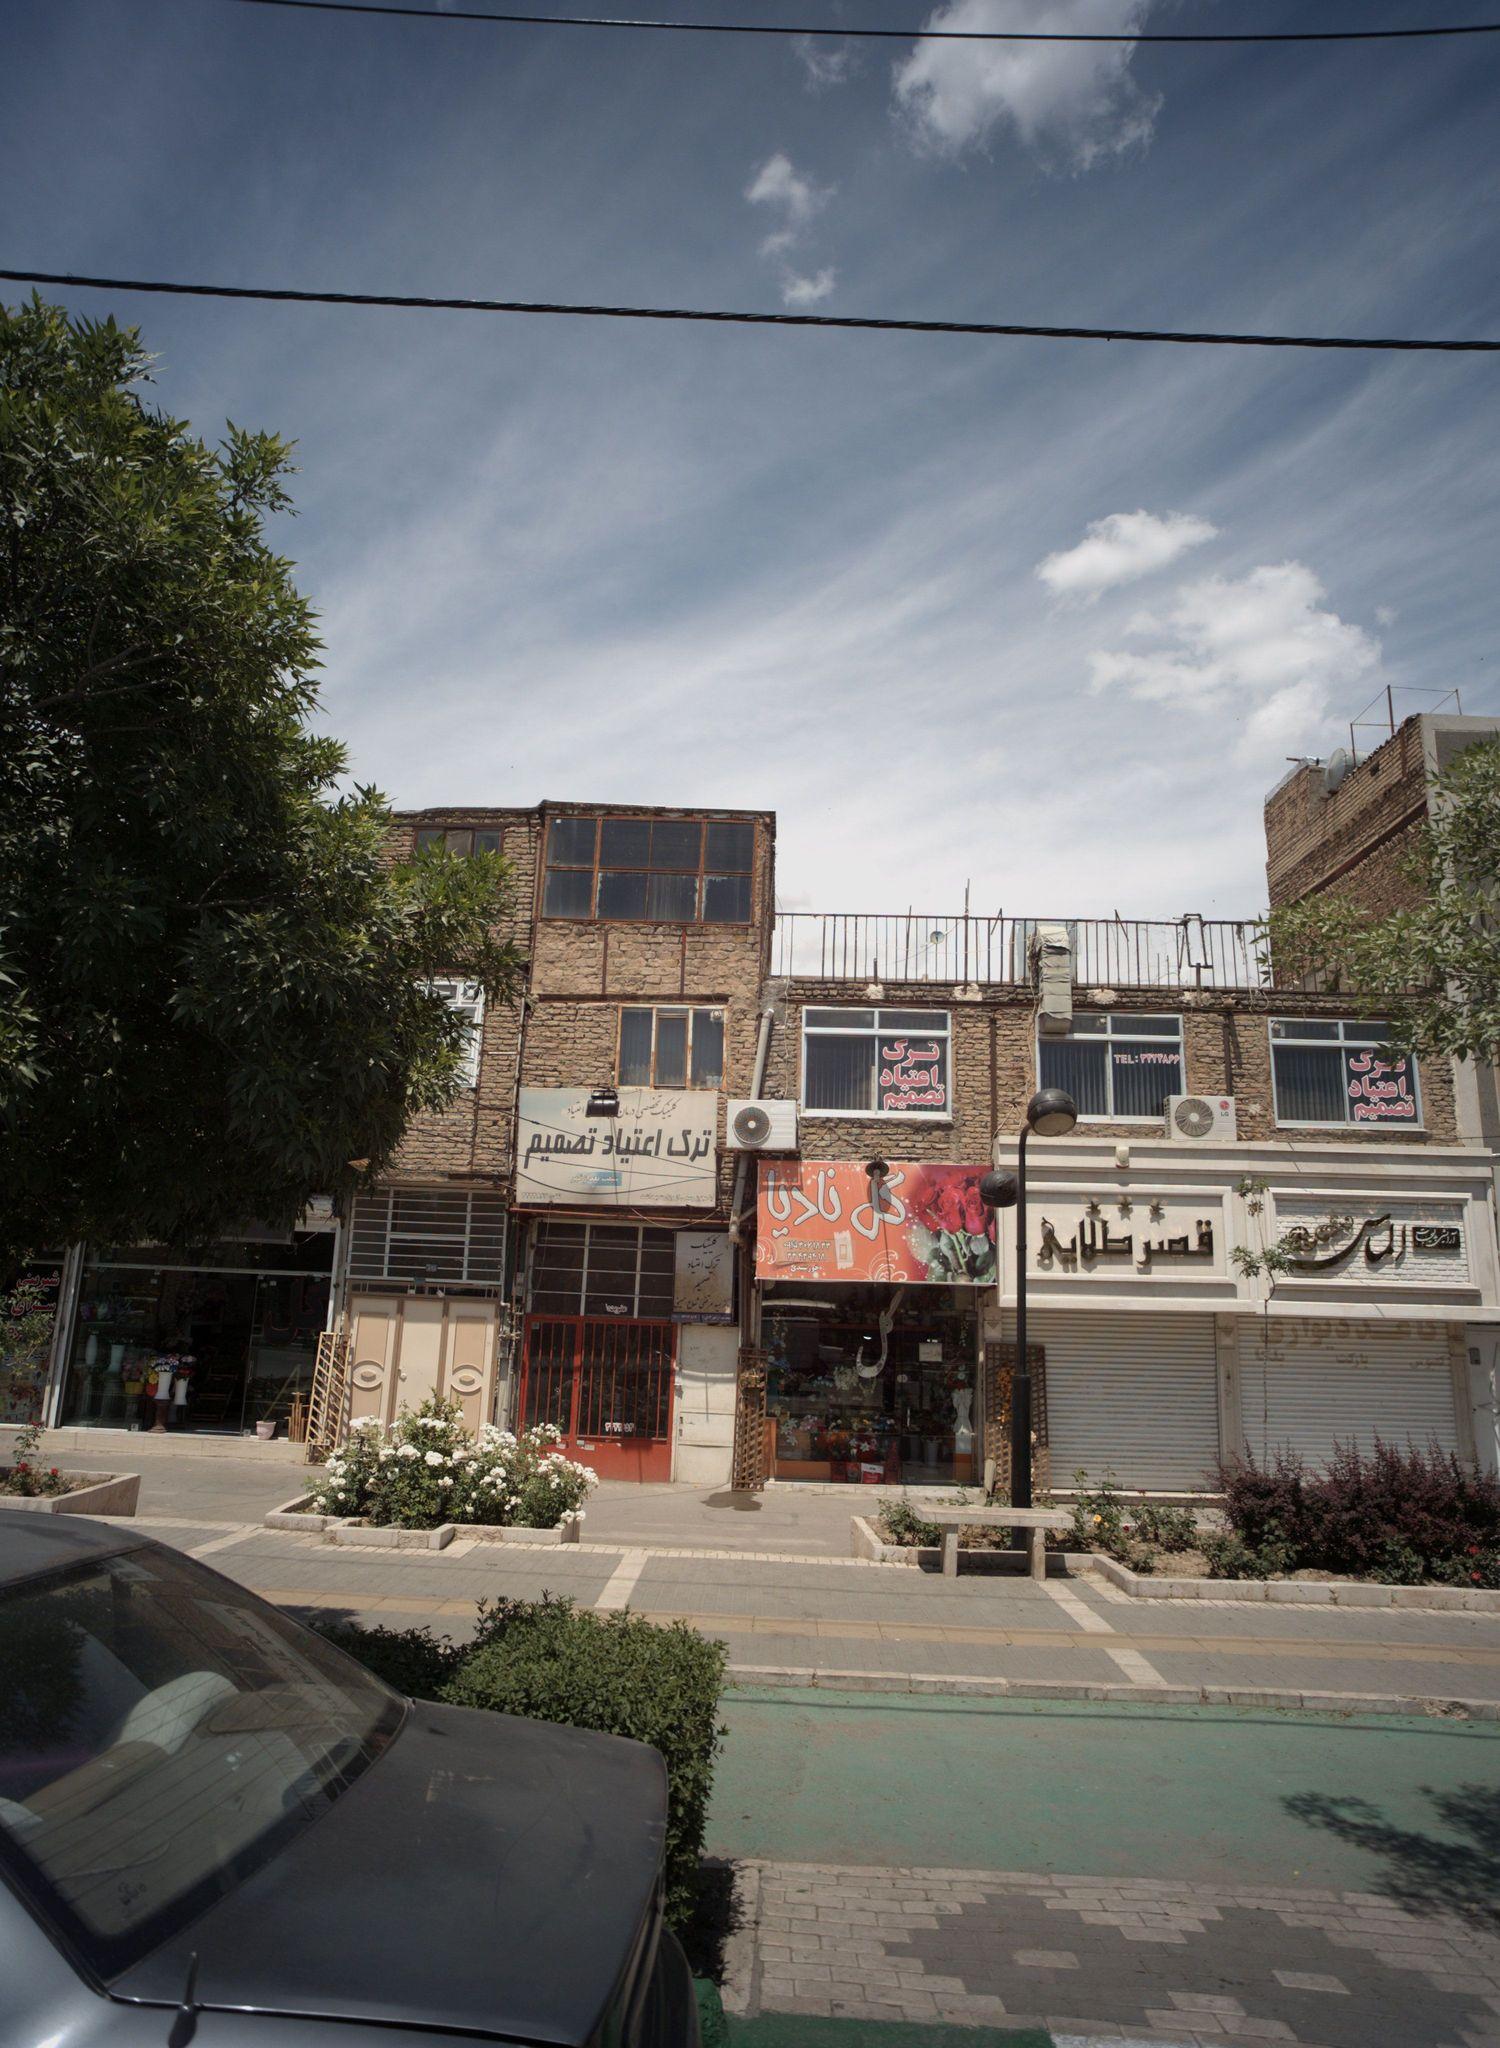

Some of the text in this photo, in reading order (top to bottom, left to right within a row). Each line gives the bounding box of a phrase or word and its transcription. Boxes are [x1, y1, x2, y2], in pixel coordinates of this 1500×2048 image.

[882, 1039, 940, 1067] ترک
[880, 1063, 939, 1091] اعتیاد
[1348, 1075, 1407, 1102] اعتیاد
[884, 1083, 945, 1112] تصمیم
[1353, 1094, 1414, 1121] تصمیم
[523, 1128, 712, 1169] ترک اعتیاد تصمیم
[767, 1168, 906, 1240] گل نادیا
[1136, 1219, 1214, 1266] قصر
